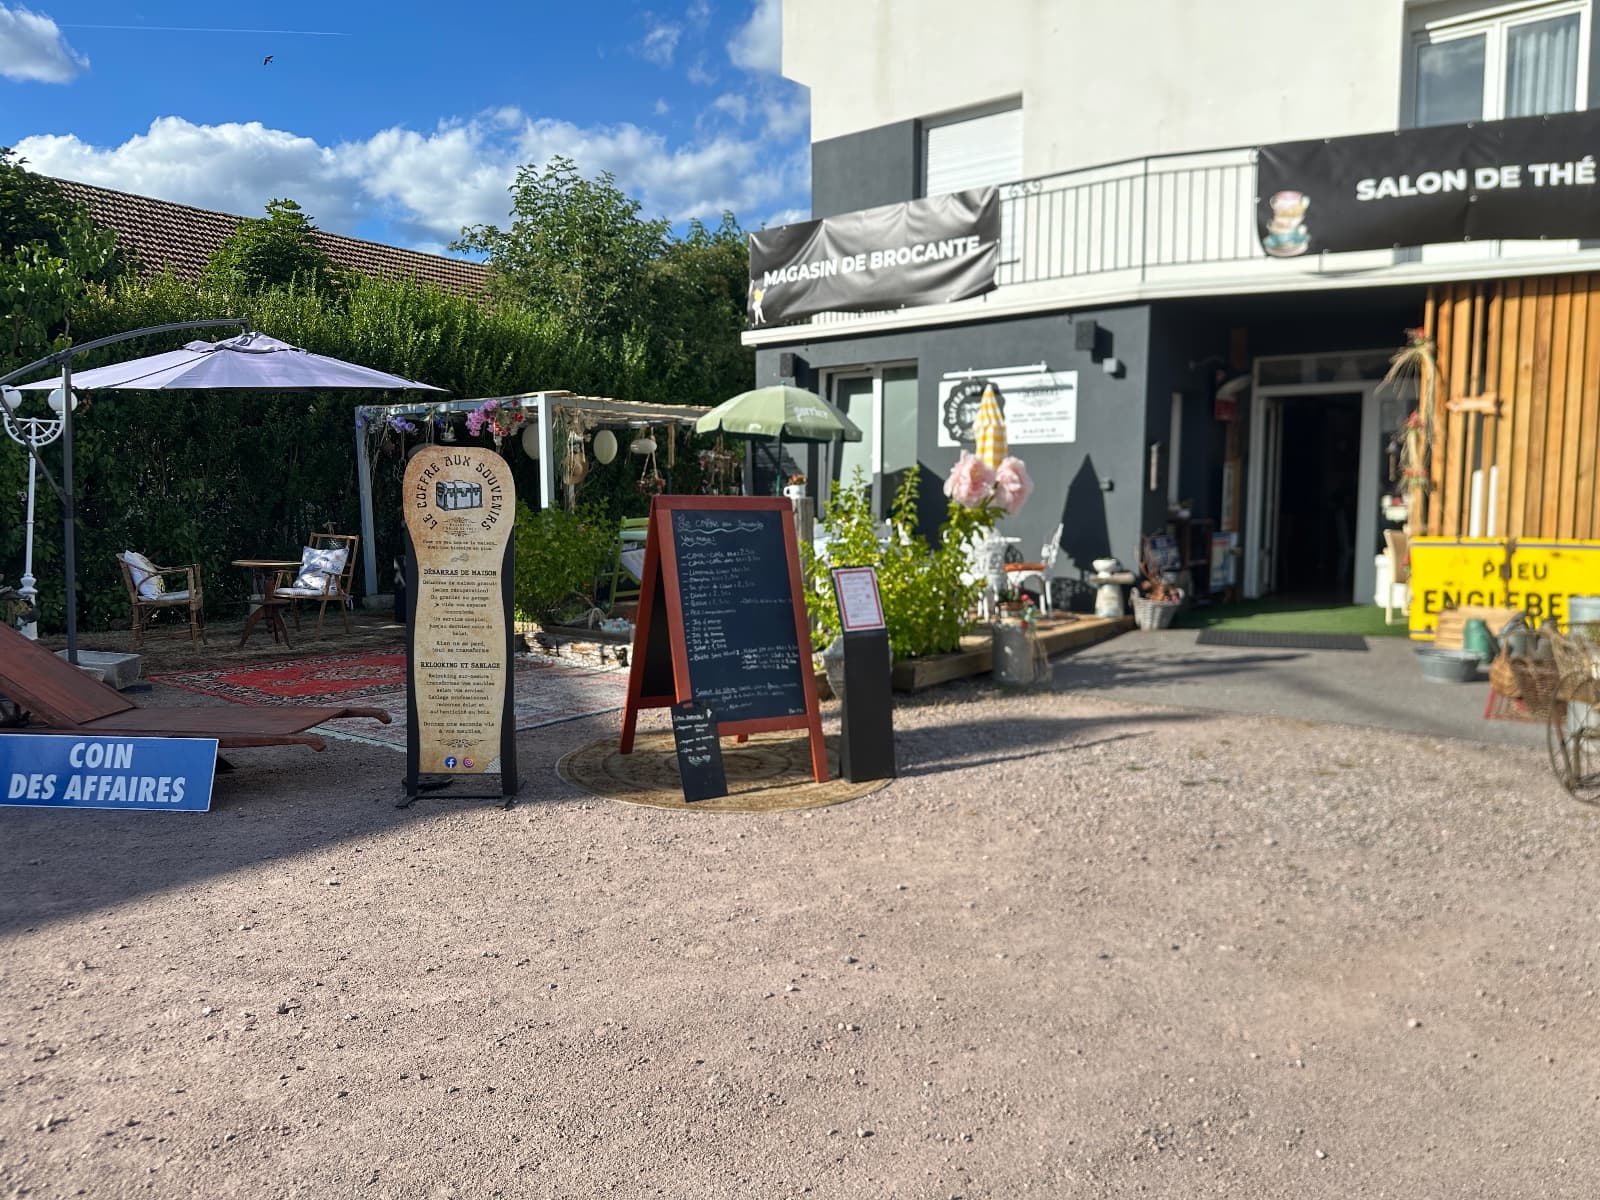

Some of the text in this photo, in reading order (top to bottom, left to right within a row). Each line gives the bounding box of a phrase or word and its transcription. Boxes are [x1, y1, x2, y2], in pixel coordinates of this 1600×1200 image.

[1356, 155, 1597, 201] SALON DE THÉ
[763, 235, 980, 287] MAGASIN DE BROCANTE
[416, 454, 503, 531] LE COFFRE AUX SOUVENIRS
[423, 568, 459, 576] DÉBARRAS
[471, 569, 497, 577] MAISON
[1423, 589, 1578, 619] ENGLEBE
[420, 661, 458, 669] RELOOKING
[69, 742, 134, 769] COIN
[8, 773, 186, 803] DES AFFAIRES
